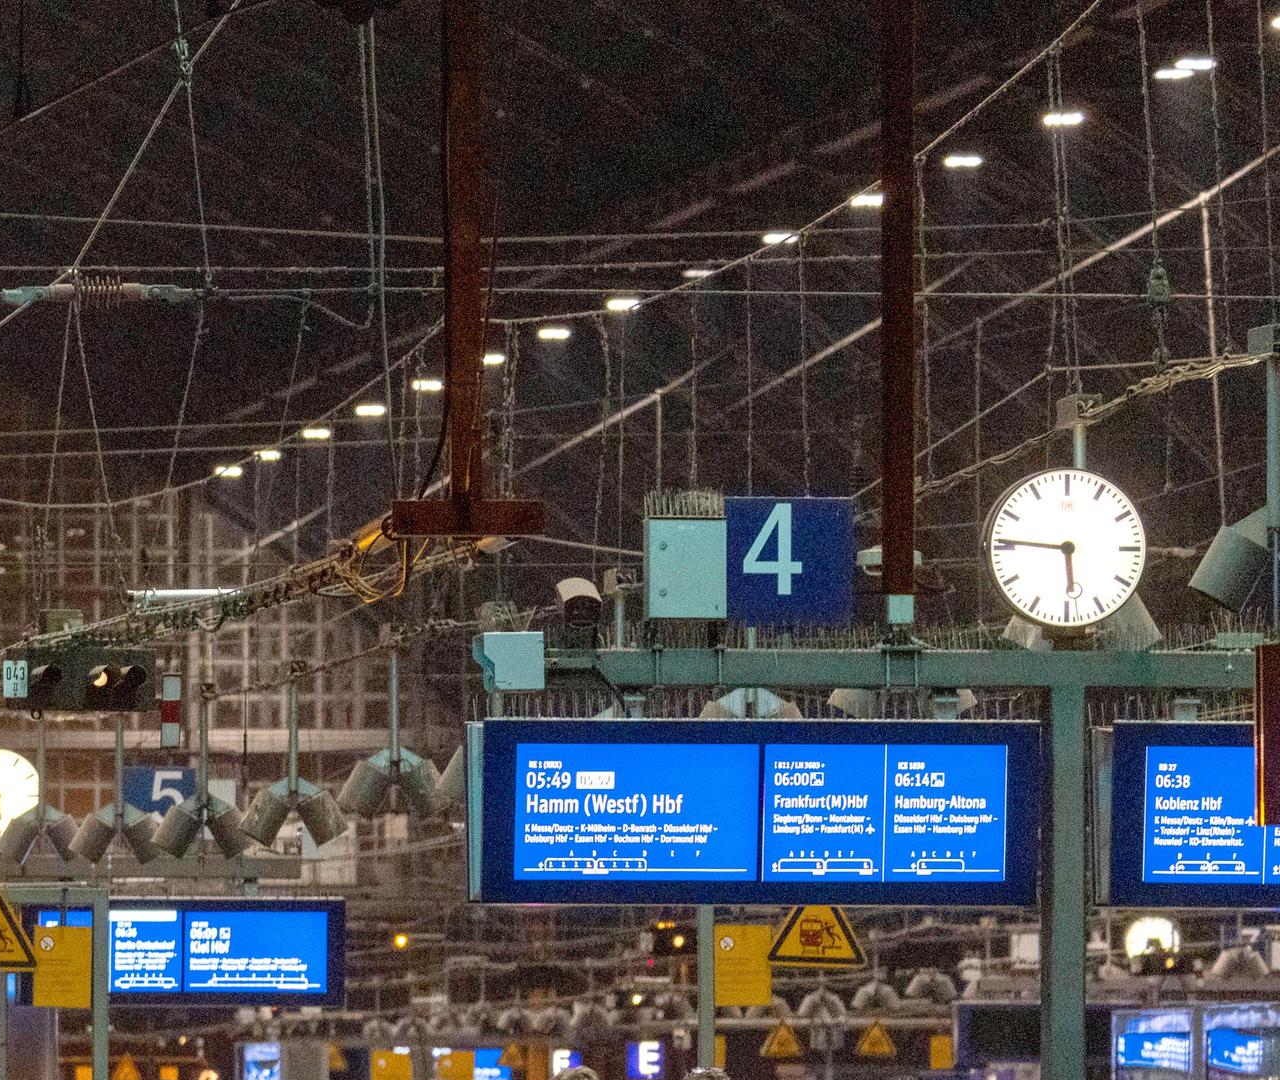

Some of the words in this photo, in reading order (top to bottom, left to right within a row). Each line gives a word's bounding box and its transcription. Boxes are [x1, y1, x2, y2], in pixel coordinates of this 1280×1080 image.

[743, 503, 802, 595] 4
[6, 666, 25, 681] 043
[526, 771, 571, 789] 05:49
[774, 772, 810, 786] 06:00
[894, 772, 930, 787] 06:14
[1155, 774, 1191, 788] 06:38
[151, 770, 185, 822] 5
[774, 794, 868, 810] Frankfurt(M)Hbf
[894, 794, 987, 812] Hamburg-Altona
[1155, 796, 1199, 811] Koblenz
[1201, 796, 1223, 811] Hbf
[526, 794, 579, 813] Hamm
[584, 793, 647, 817] (Westf)
[652, 793, 683, 814] Hbf
[639, 1042, 660, 1074] E
